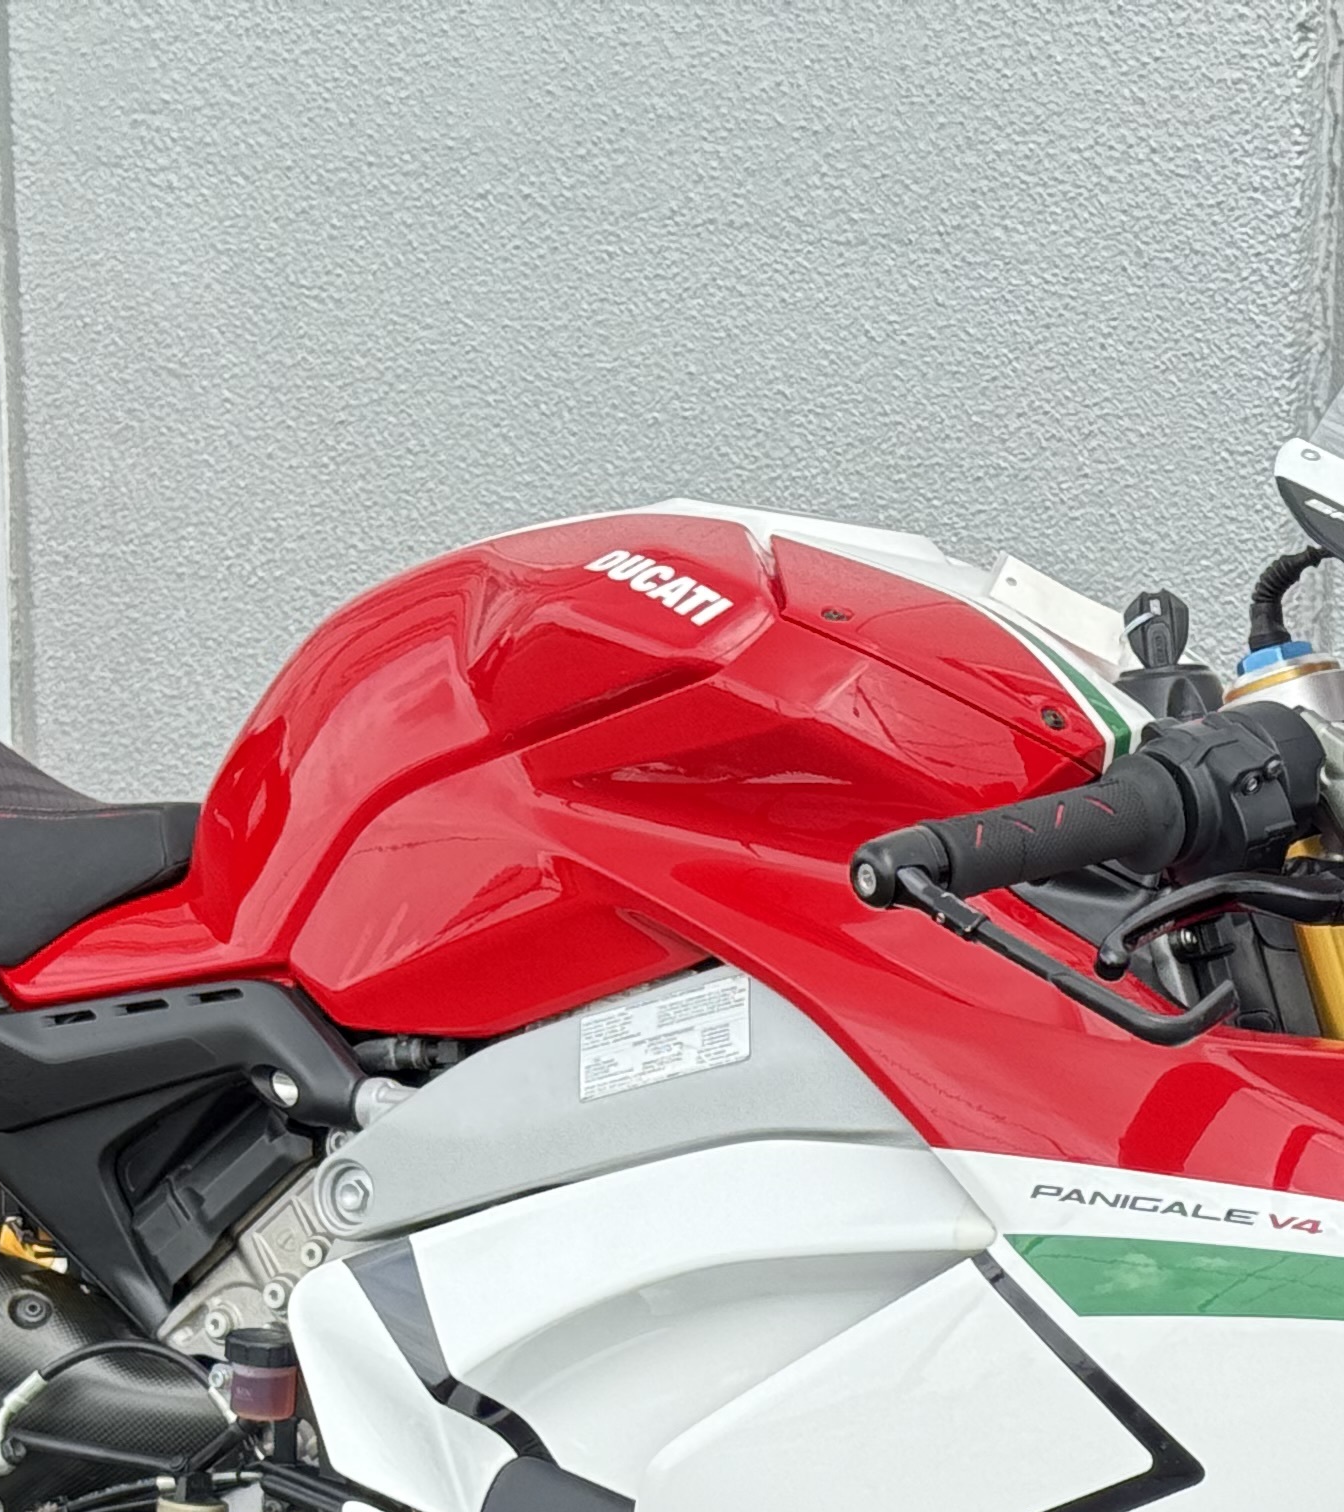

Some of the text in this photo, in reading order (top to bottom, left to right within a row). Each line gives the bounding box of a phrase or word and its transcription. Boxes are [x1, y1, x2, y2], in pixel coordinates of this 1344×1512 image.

[583, 550, 734, 627] DUCATI
[1029, 1184, 1324, 1235] PANIGALE V4
